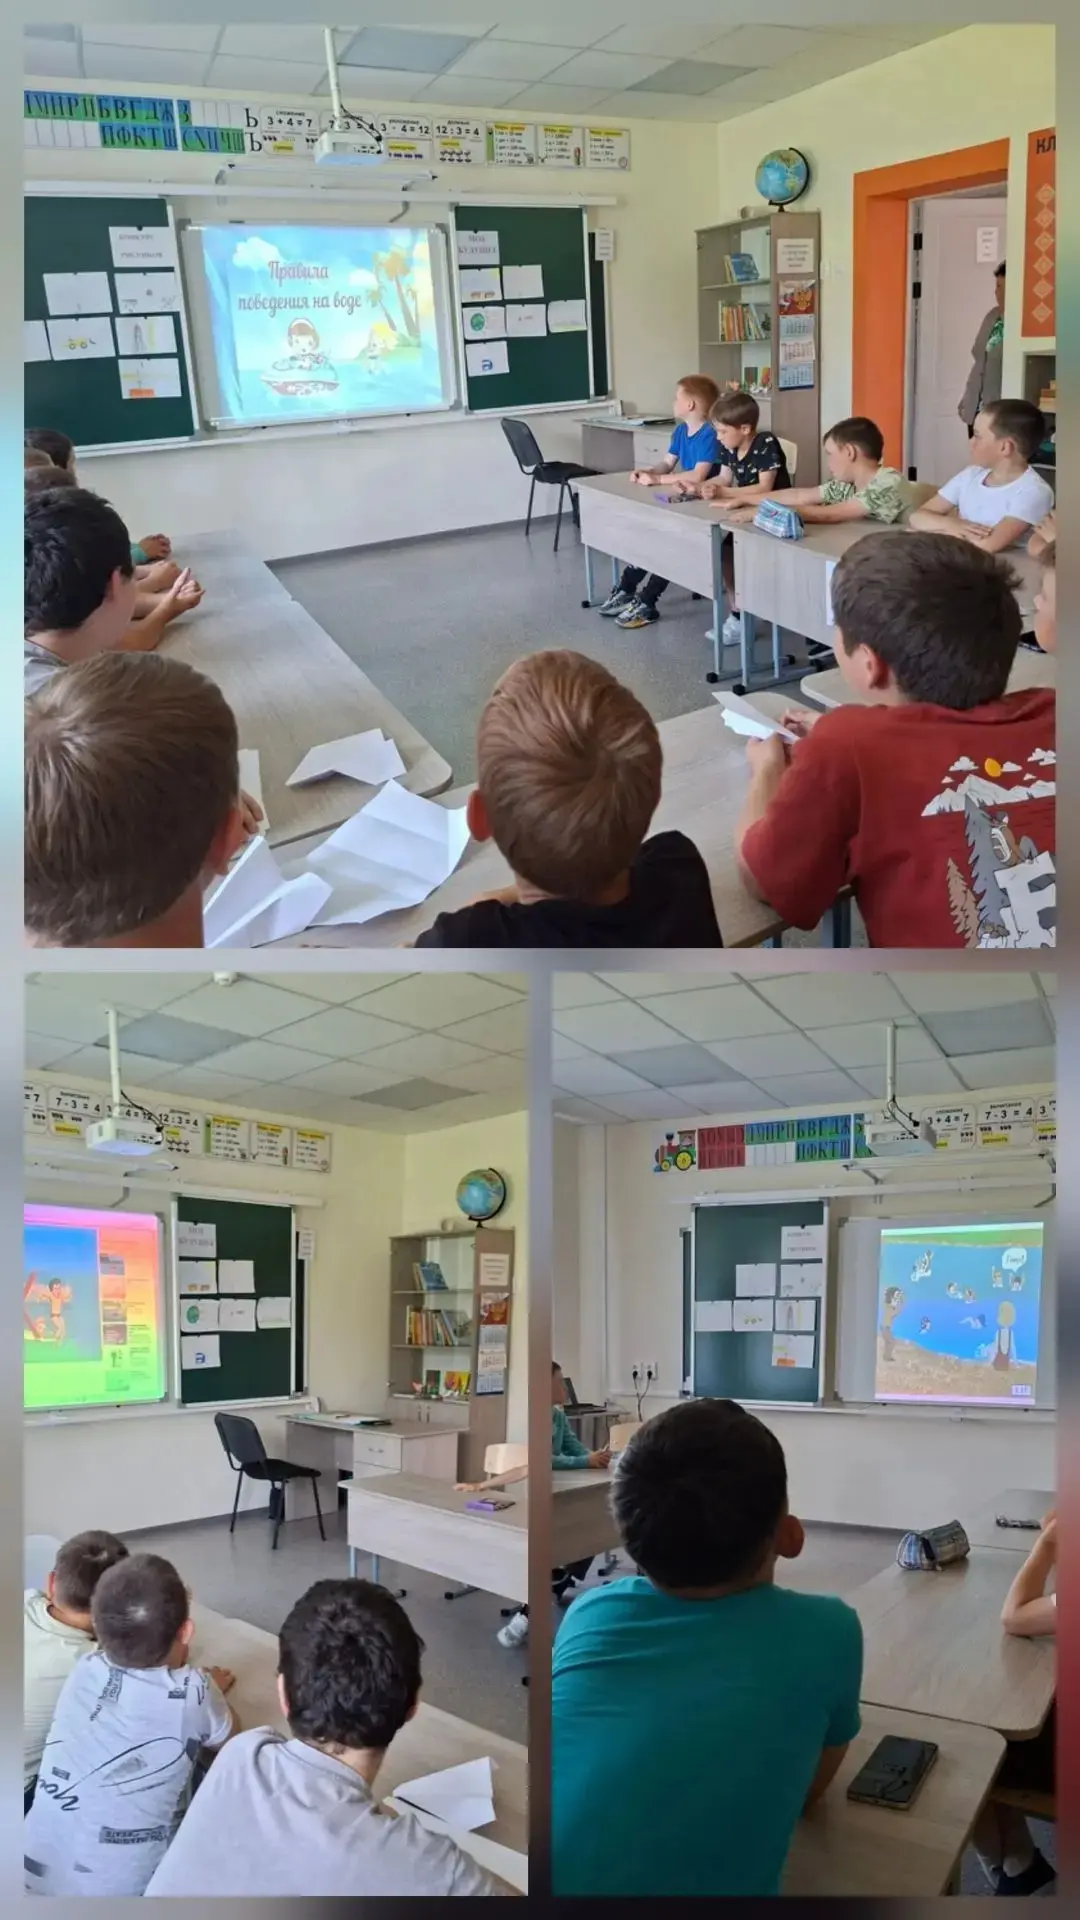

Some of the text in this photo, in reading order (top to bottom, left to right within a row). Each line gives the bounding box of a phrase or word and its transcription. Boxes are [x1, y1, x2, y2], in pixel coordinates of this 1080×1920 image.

[267, 115, 274, 125] 3
[286, 117, 294, 126] 4
[305, 118, 313, 127] 7
[380, 123, 387, 132] 3
[400, 124, 407, 133] 4
[418, 125, 430, 134] 12
[436, 125, 448, 134] 12
[456, 126, 462, 135] 3
[473, 127, 480, 136] 4
[268, 259, 329, 287] Правила
[237, 291, 362, 318] поведения на воде
[33, 1093, 40, 1103] 7
[55, 1097, 63, 1106] 7
[71, 1099, 78, 1109] 3
[94, 1103, 101, 1113] 4
[1039, 1106, 1046, 1115] 3
[944, 1115, 951, 1124] 4
[963, 1113, 970, 1122] 7
[985, 1111, 992, 1120] 7
[1000, 1110, 1007, 1119] 3
[1025, 1107, 1033, 1116] 4
[177, 1115, 183, 1125] 3
[192, 1118, 199, 1127] 4
